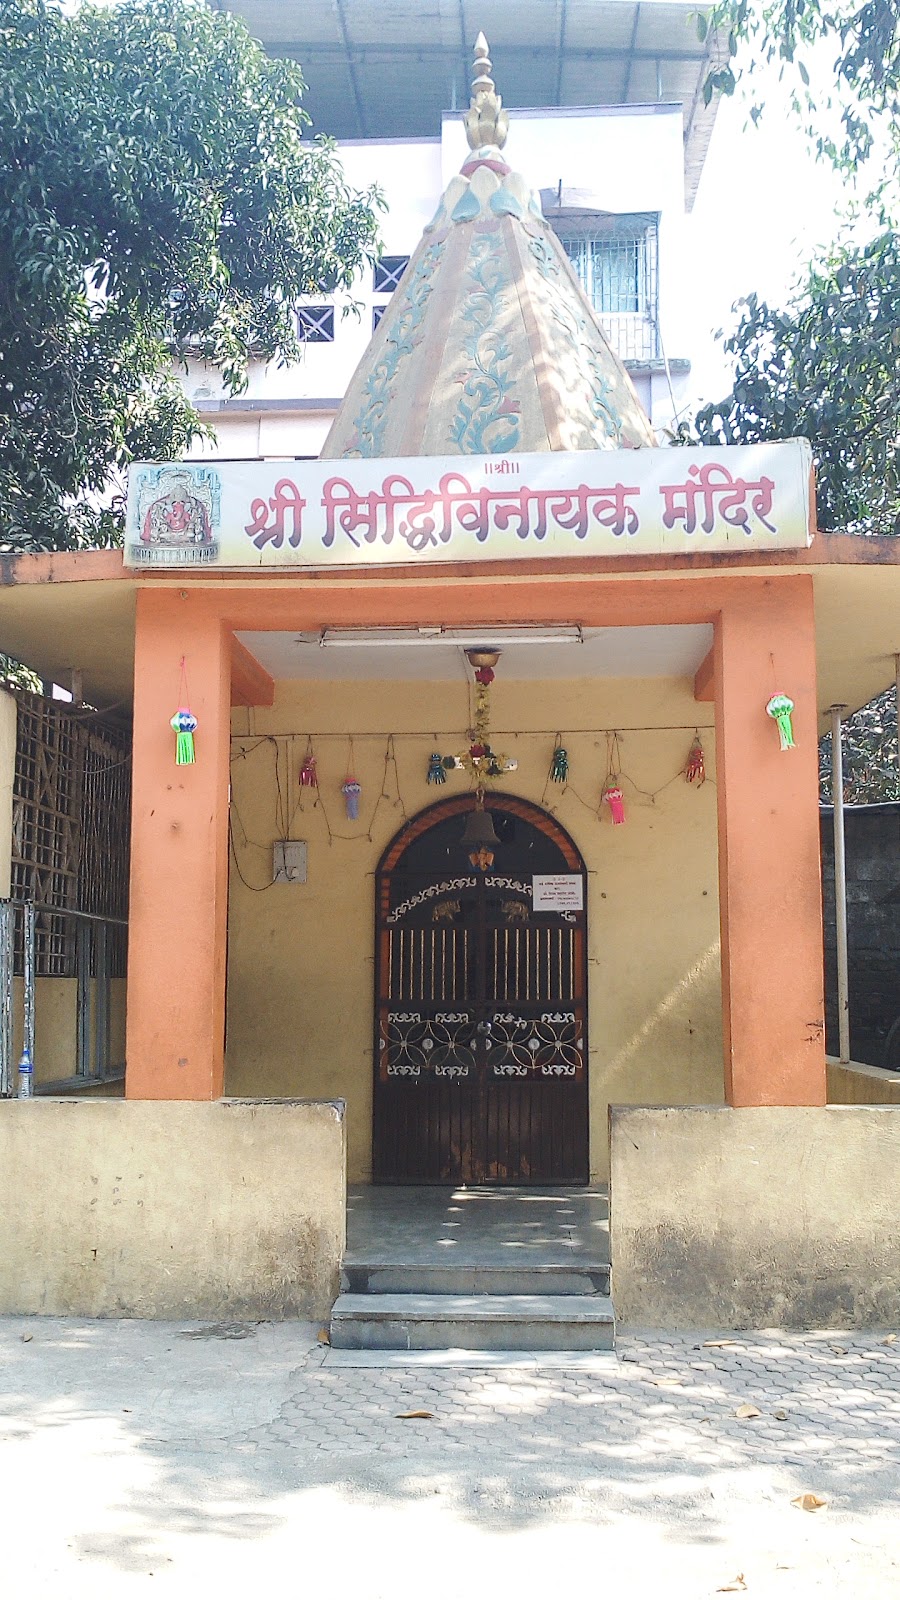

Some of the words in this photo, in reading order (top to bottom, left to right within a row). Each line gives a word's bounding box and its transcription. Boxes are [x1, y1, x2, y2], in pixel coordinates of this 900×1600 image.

[244, 478, 307, 550] श्री
[320, 472, 641, 551] सिद्धिविनायक
[659, 462, 776, 535] मंदिर
